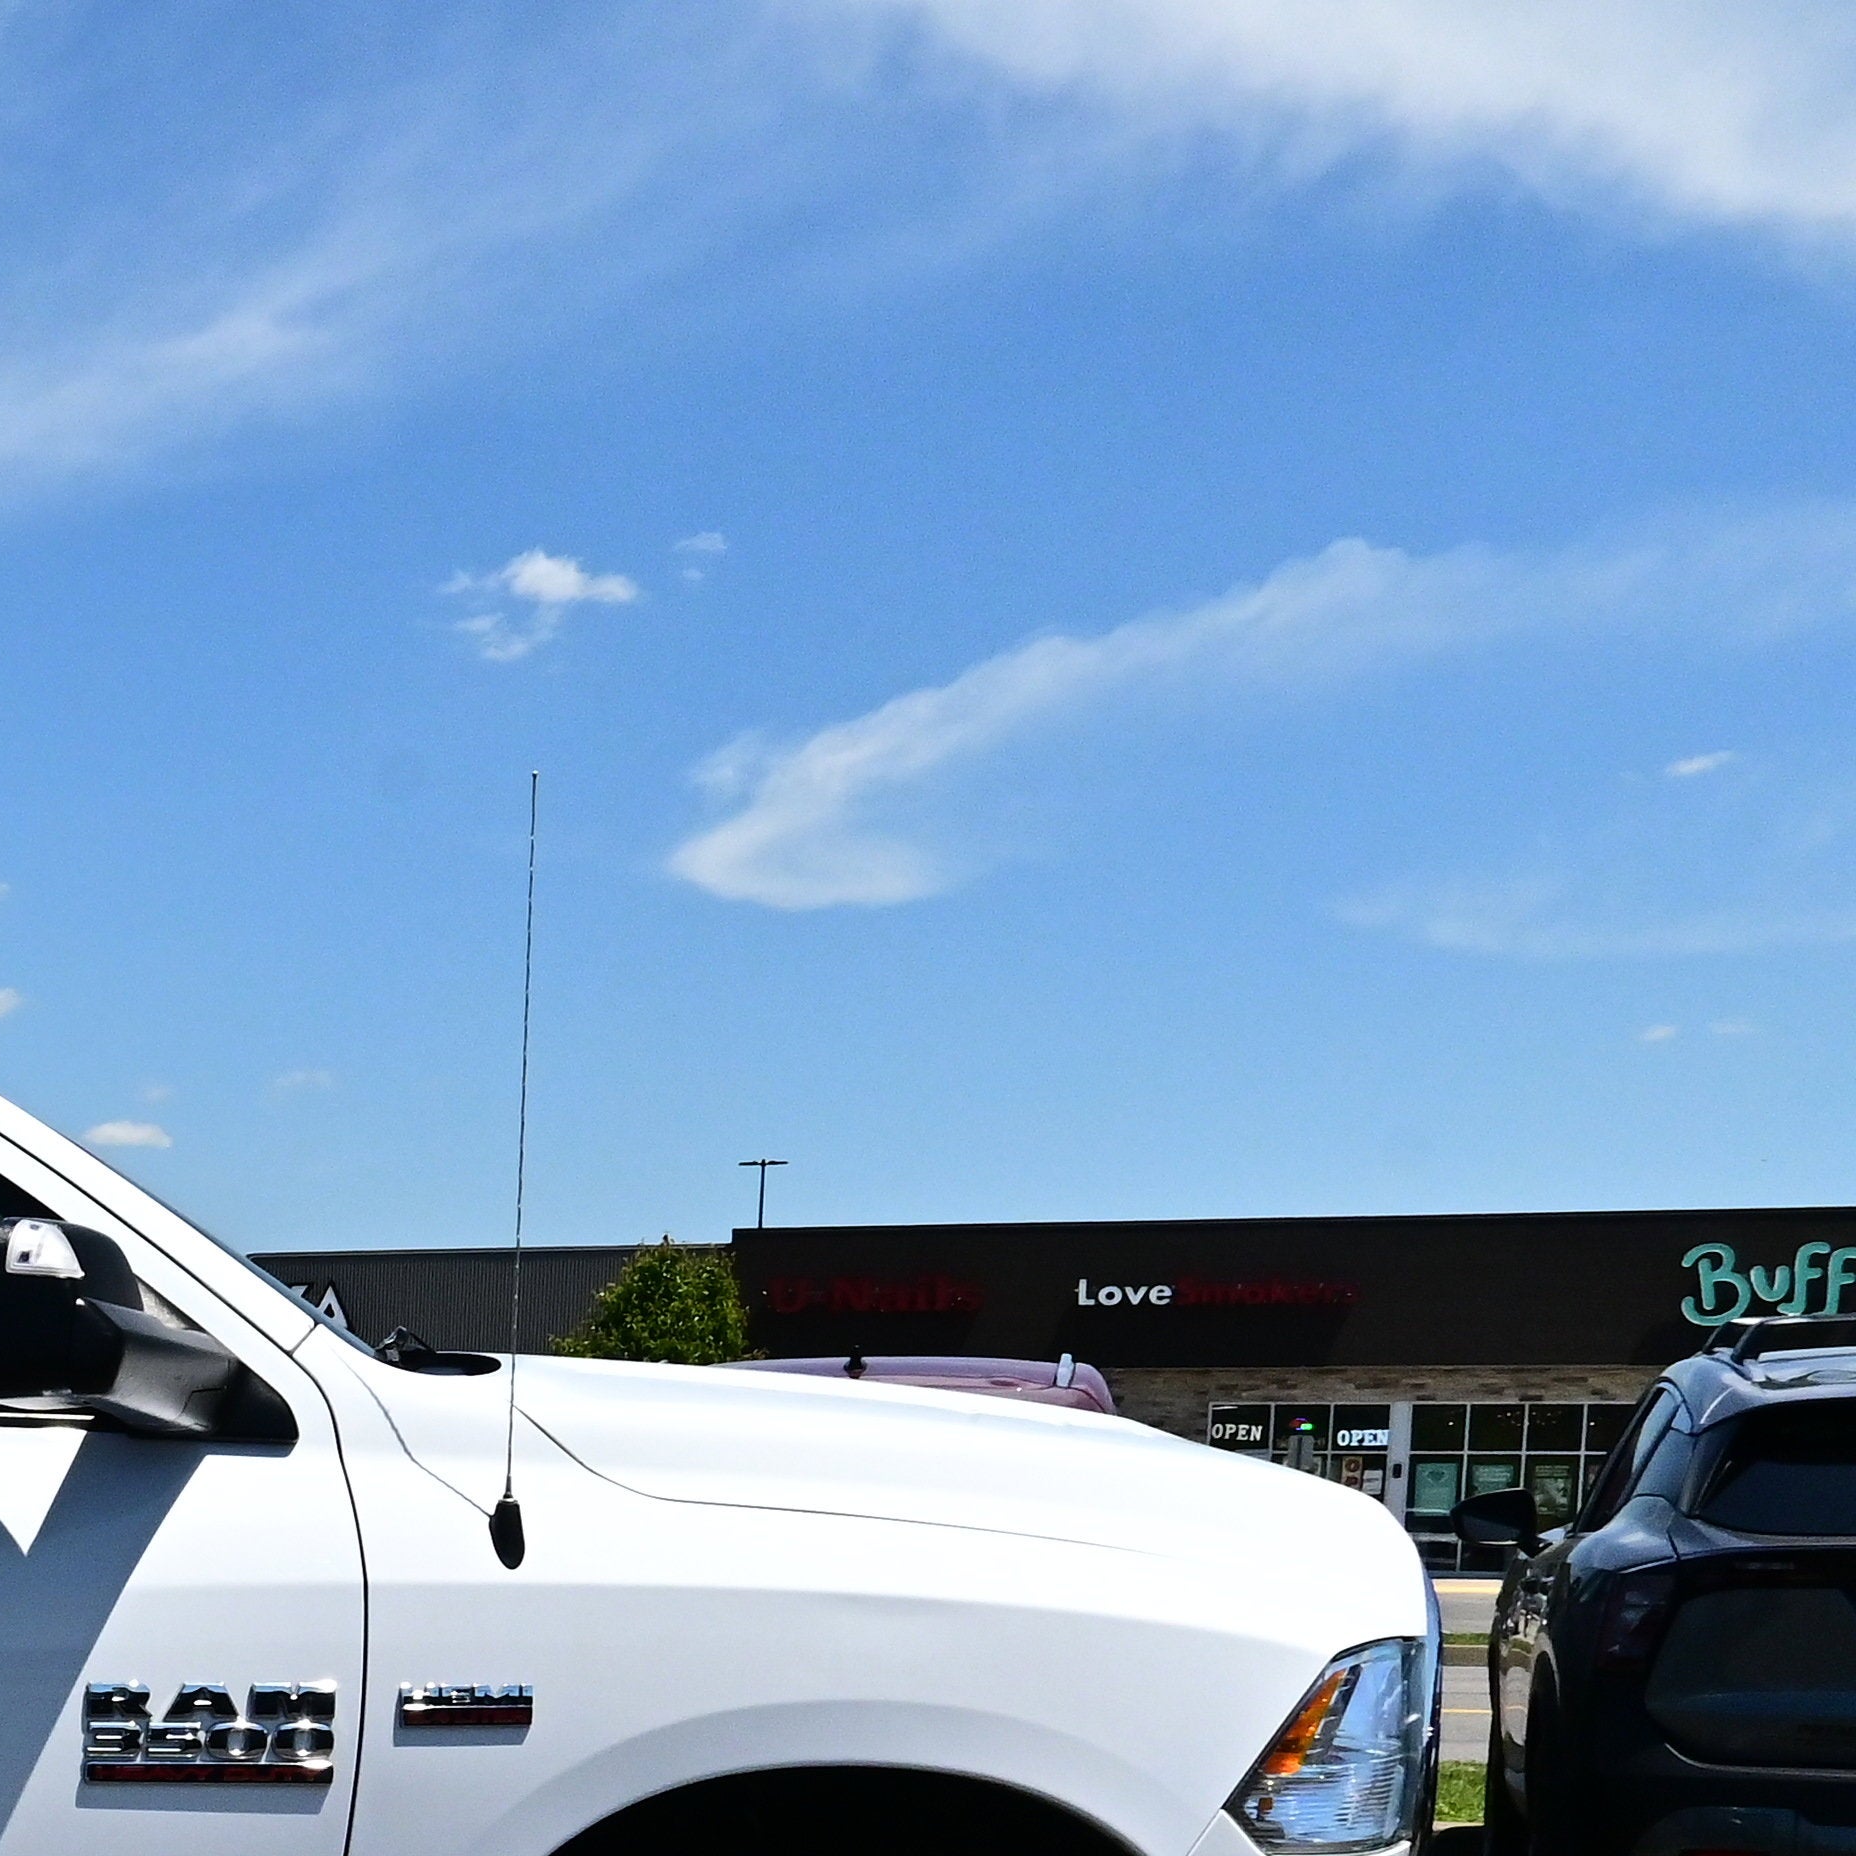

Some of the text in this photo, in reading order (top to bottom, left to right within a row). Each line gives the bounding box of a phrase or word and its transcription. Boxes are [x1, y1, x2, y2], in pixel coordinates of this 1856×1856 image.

[1211, 1423, 1263, 1441] OPEN
[1337, 1429, 1389, 1446] OPEN
[83, 1681, 336, 1720] RAM
[399, 1681, 534, 1706] HEMI
[84, 1719, 335, 1762] 3500
